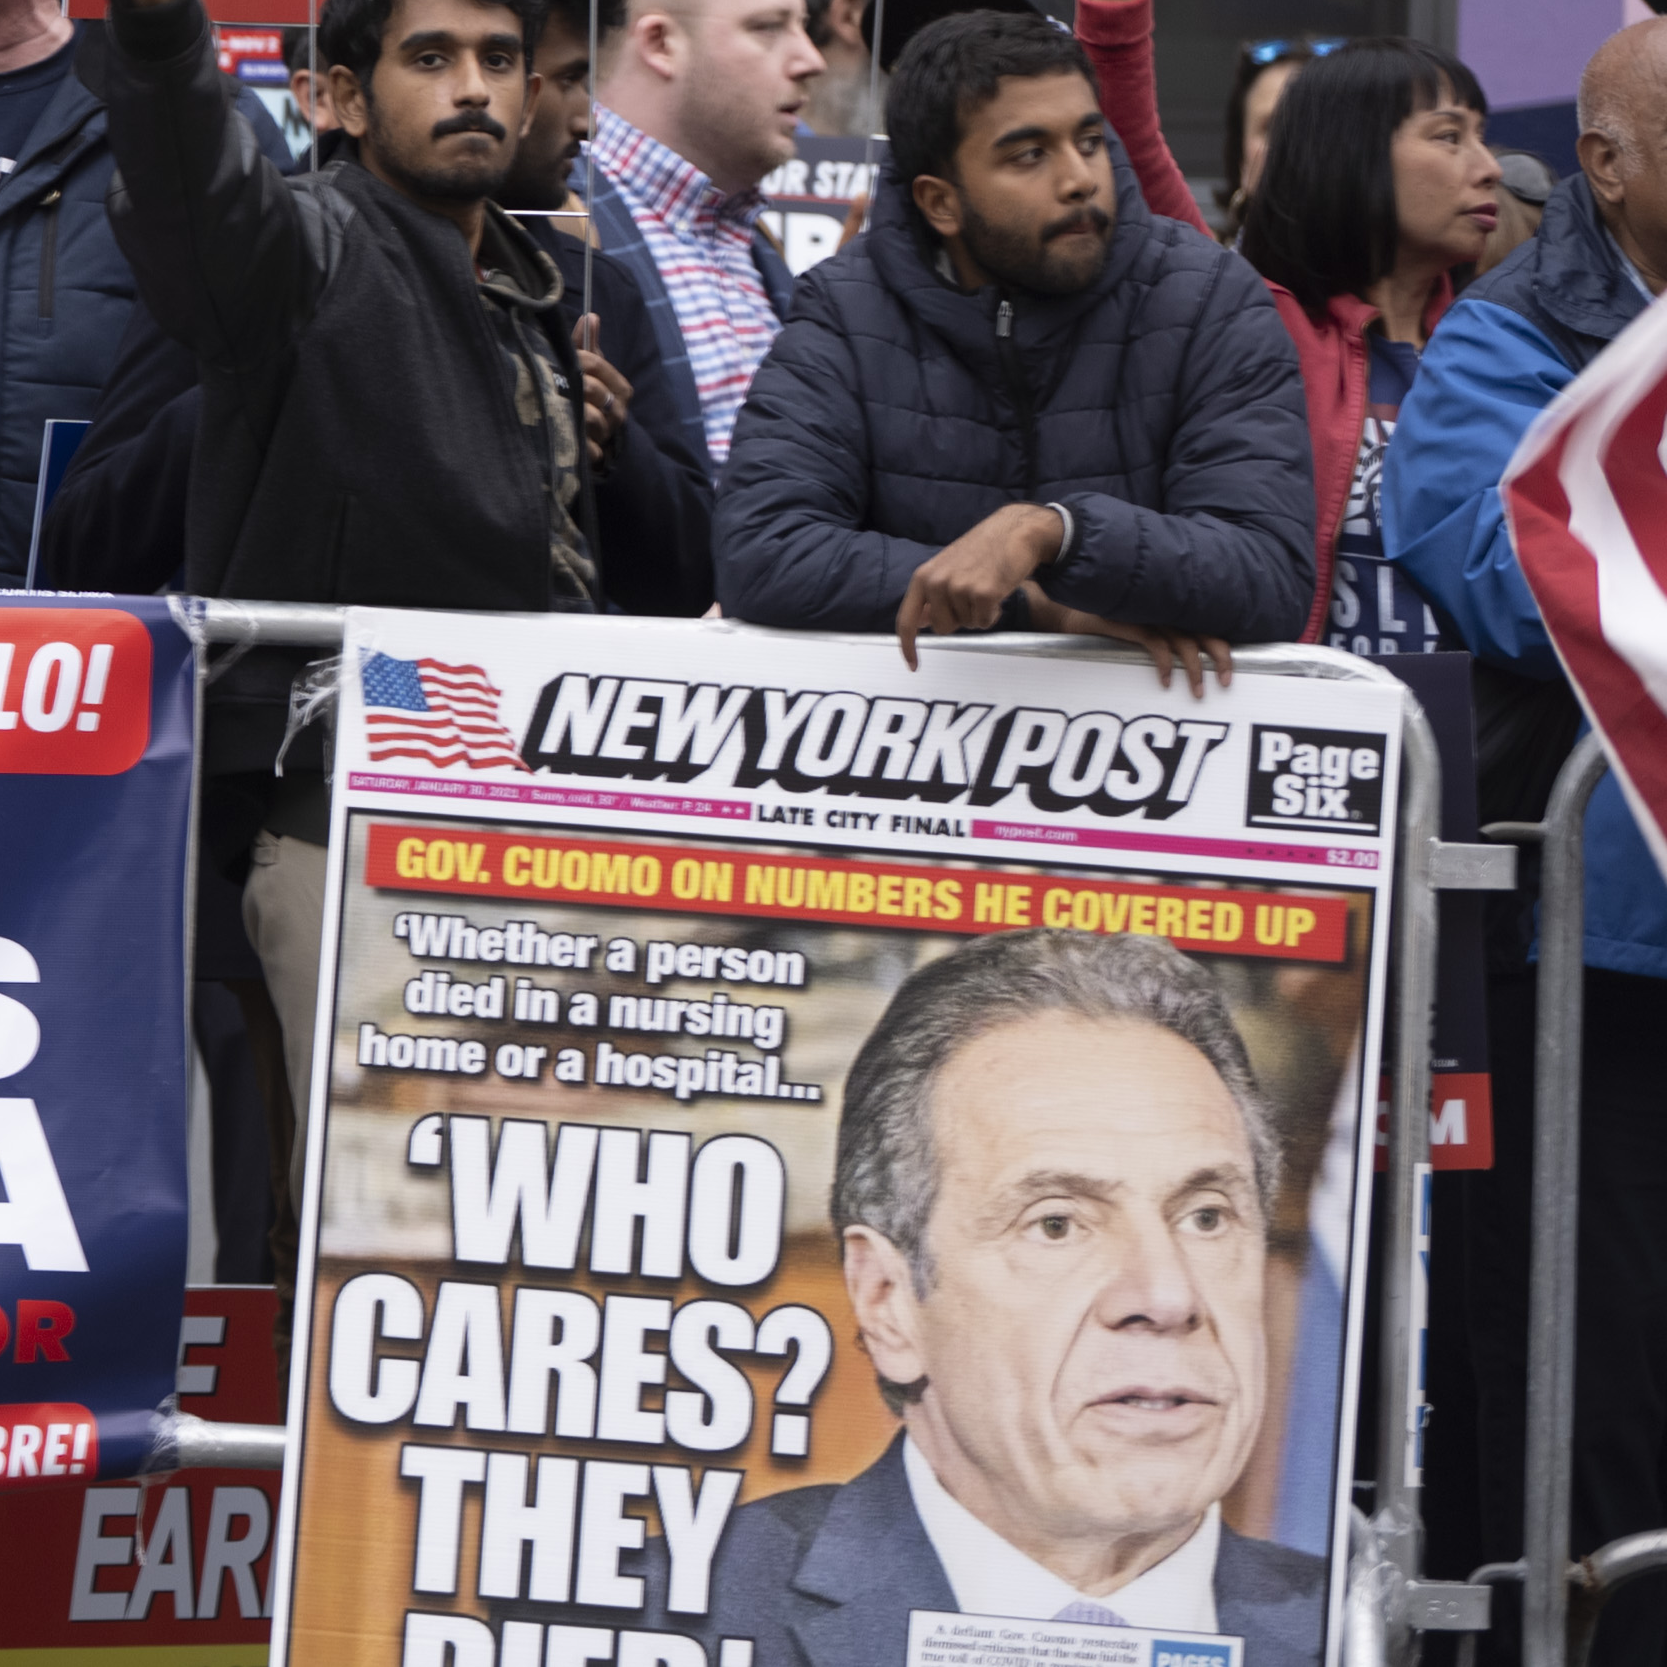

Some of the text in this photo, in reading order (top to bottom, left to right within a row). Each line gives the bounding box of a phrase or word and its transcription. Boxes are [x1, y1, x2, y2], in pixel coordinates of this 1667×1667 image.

[517, 674, 1232, 821] NEW YORK POST
[1257, 731, 1380, 789] Page
[757, 803, 967, 838] LATE CITY FINAL
[1325, 848, 1378, 868] $2.00
[396, 837, 1317, 947] GOV. CUOMO ON NUMBERS HE COVERED UP
[645, 939, 806, 986] person
[404, 970, 786, 1050] died nursing
[358, 1023, 822, 1101] home hospital...
[327, 1272, 834, 1459] CARES?
[69, 1486, 273, 1621] EAR
[400, 1442, 746, 1616] THEY
